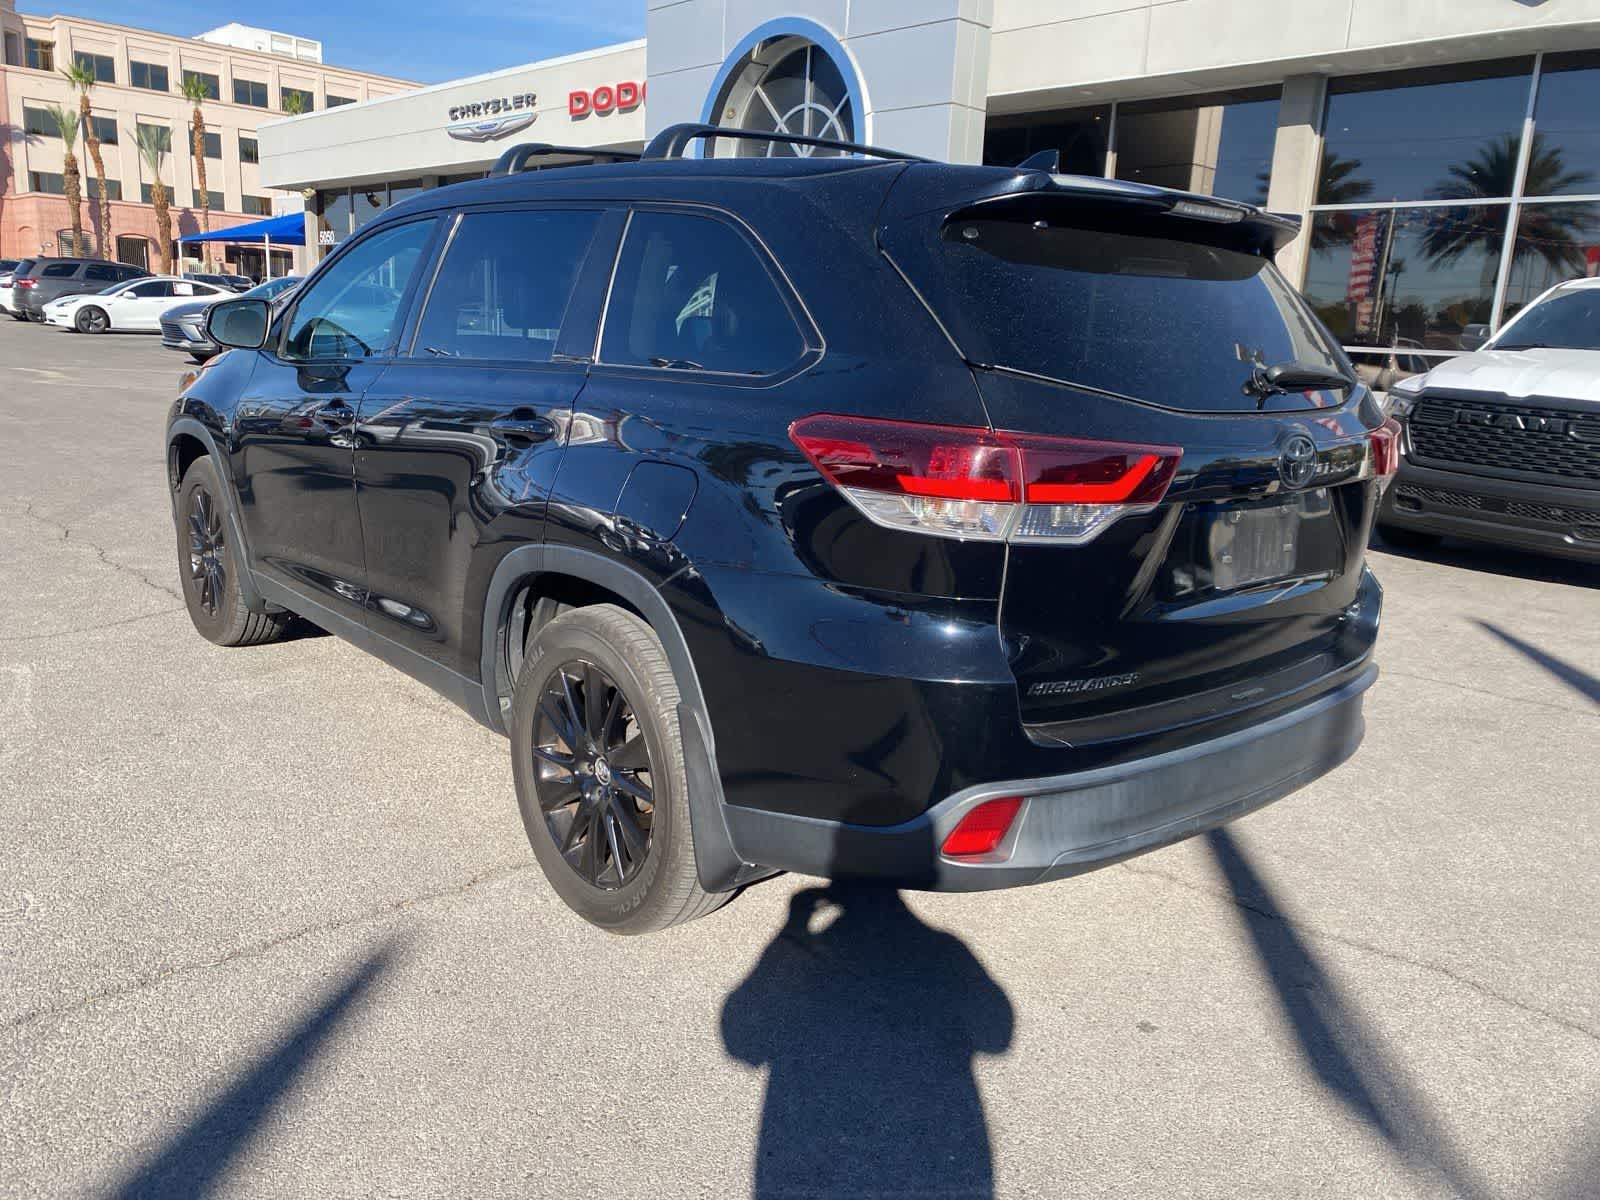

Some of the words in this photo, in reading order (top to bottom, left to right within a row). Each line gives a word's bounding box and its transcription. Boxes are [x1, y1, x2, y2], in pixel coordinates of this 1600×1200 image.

[449, 92, 537, 121] CHRYSLER
[568, 81, 647, 120] DOD
[319, 230, 335, 243] 5050
[1027, 672, 1141, 696] HIGHLANDER
